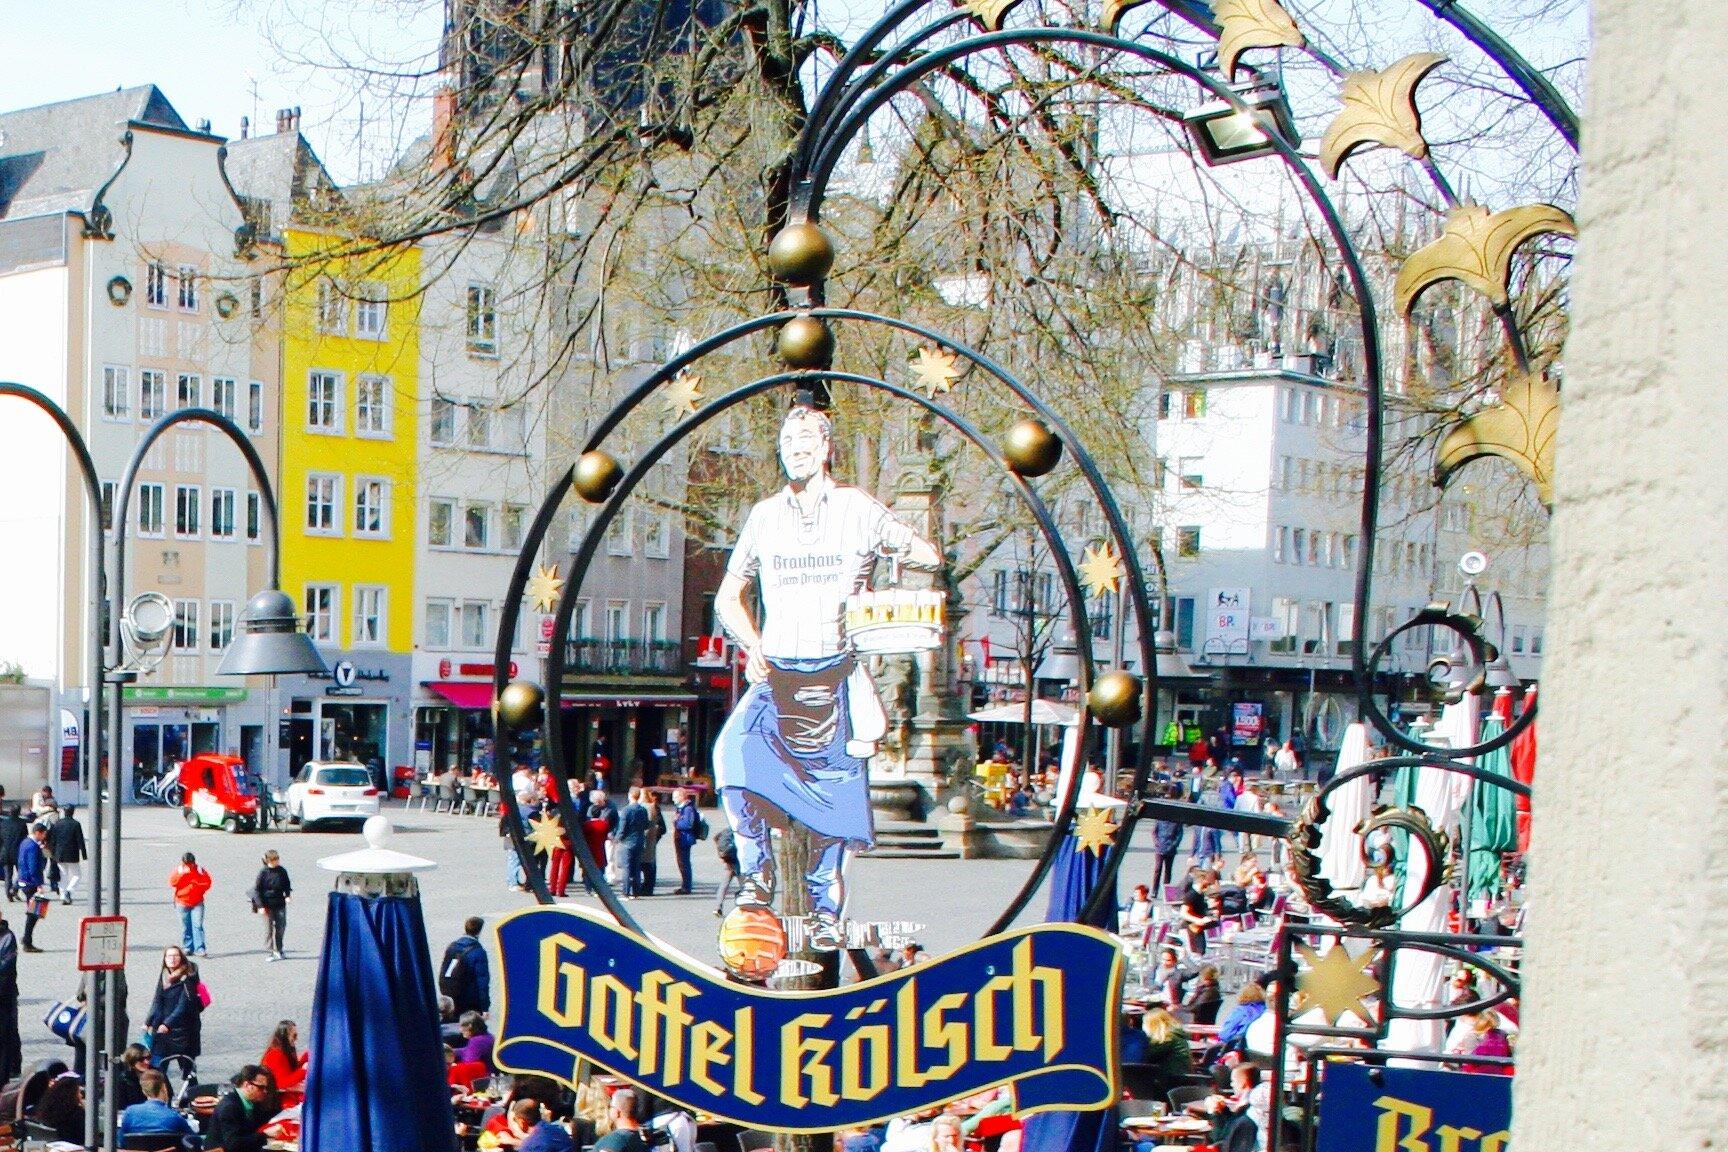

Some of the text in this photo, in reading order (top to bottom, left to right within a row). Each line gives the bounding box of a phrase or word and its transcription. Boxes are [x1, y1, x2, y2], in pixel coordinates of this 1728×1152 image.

[773, 553, 843, 571] Brauhaus
[536, 931, 1064, 1110] Gaffel Kölsch
